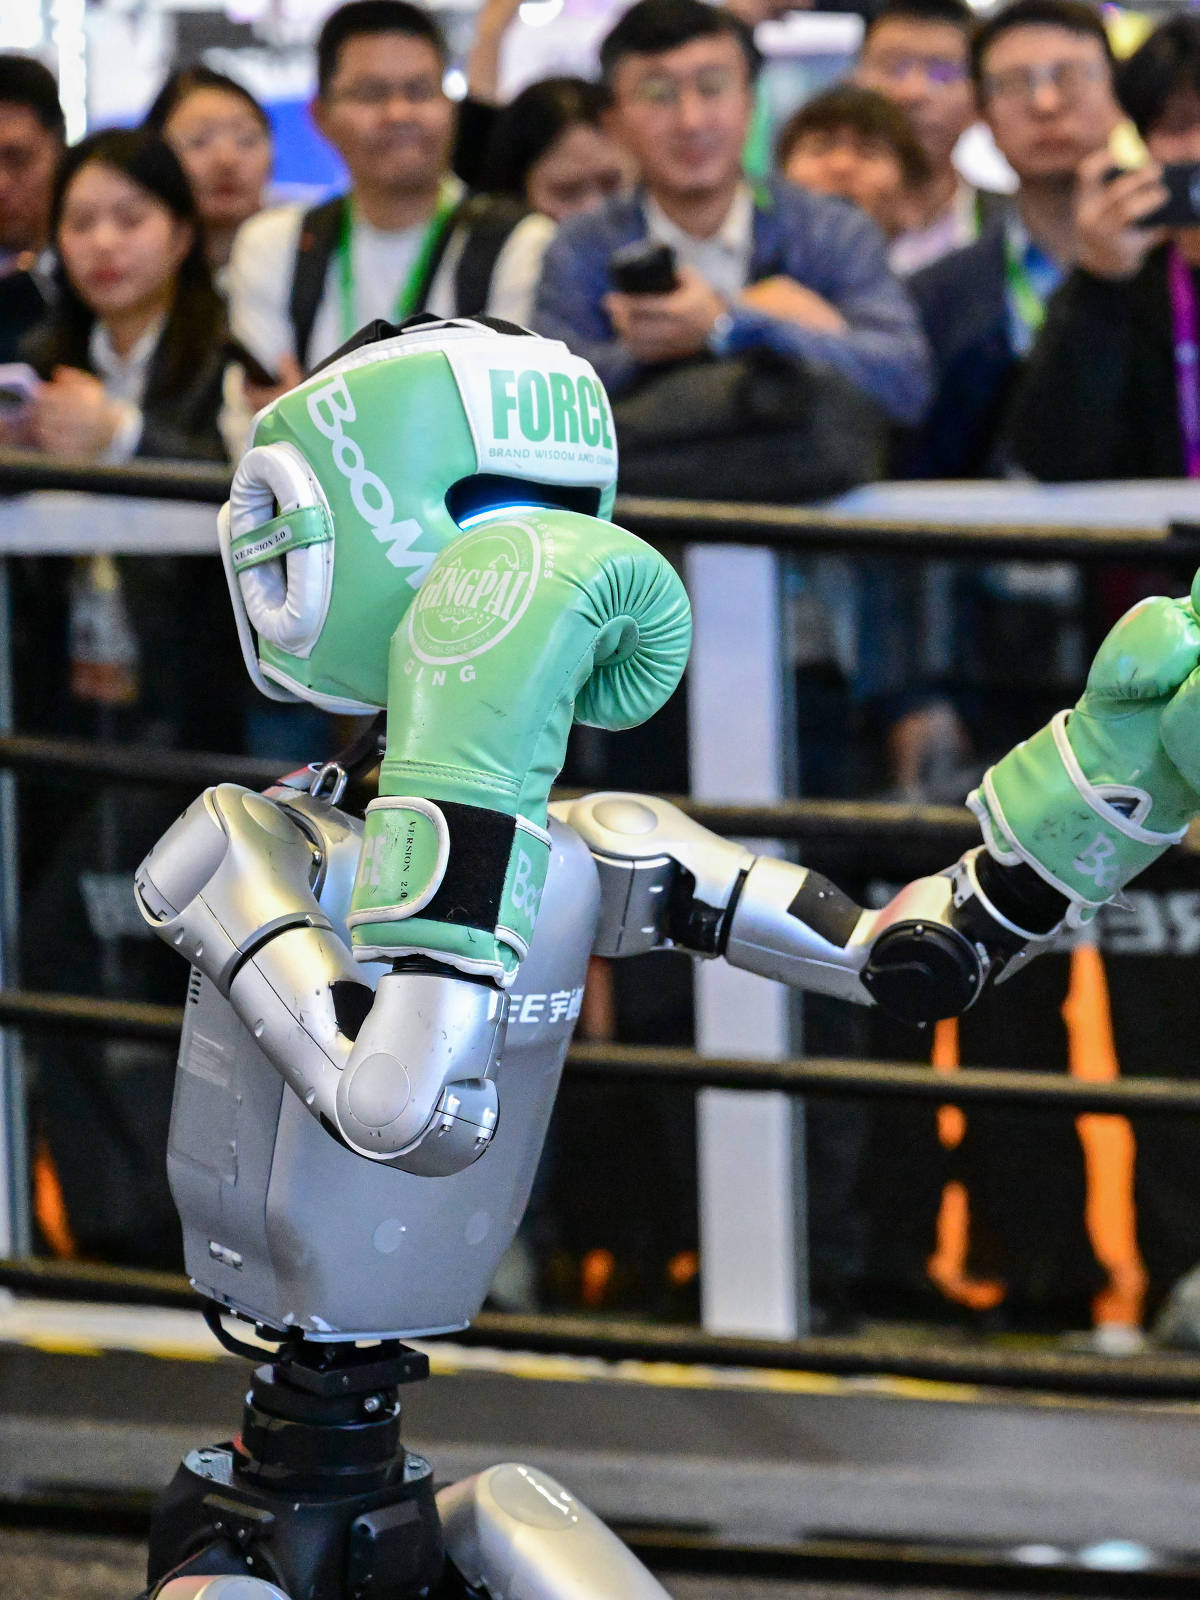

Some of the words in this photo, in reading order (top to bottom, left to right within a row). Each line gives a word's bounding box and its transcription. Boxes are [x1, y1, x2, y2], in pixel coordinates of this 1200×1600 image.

[489, 369, 613, 450] FORCE
[488, 447, 530, 459] BRAND
[534, 448, 575, 461] WISDOM
[234, 538, 274, 561] VERSION
[402, 821, 417, 872] VERSION
[400, 881, 409, 898] 2.0
